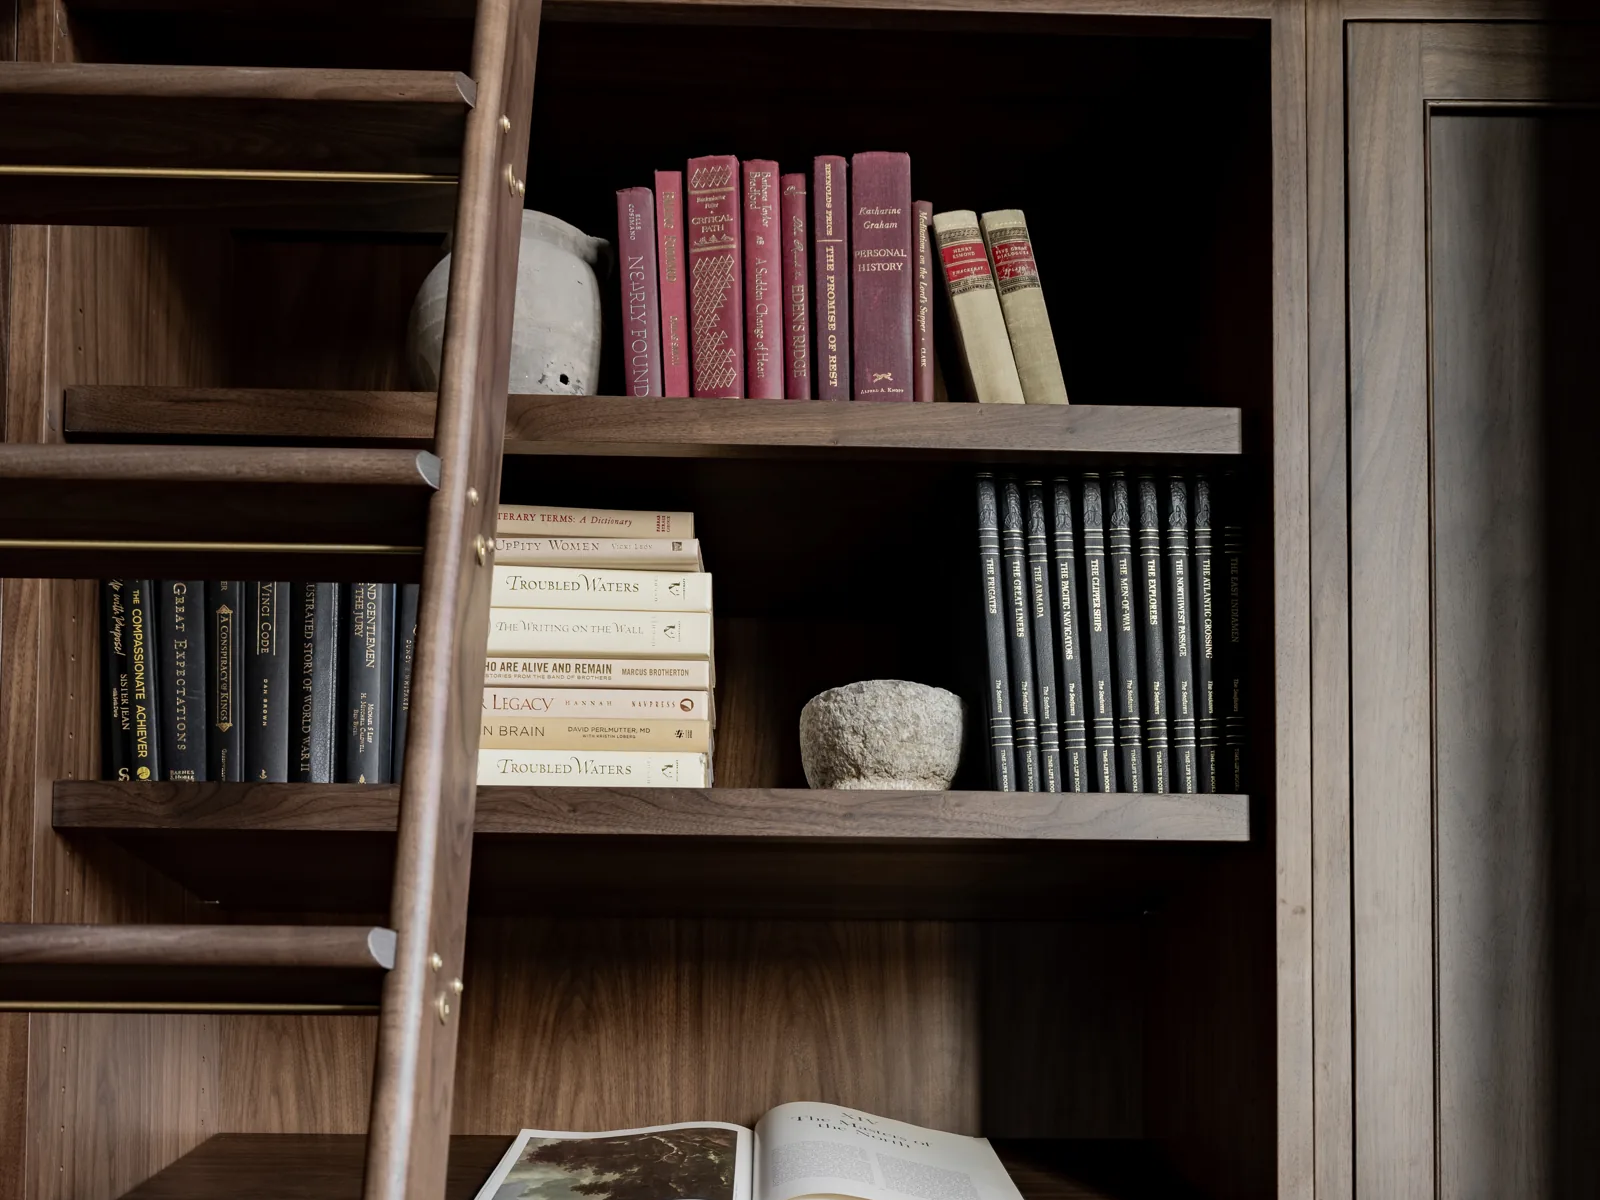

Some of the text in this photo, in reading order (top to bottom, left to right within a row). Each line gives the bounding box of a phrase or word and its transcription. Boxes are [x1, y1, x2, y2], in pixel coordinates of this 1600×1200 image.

[748, 171, 760, 210] Bradford
[761, 171, 771, 227] Barbara Taylor
[859, 206, 901, 215] Katharine
[628, 204, 636, 240] COSIMANO
[692, 215, 733, 224] CRITICAL
[702, 224, 724, 232] PATH
[863, 220, 898, 229] Graham
[855, 249, 907, 258] PERSONAL
[858, 263, 903, 272] HISTORY
[917, 210, 927, 332] Meditations on the Supper
[755, 267, 767, 300] Sudden
[755, 304, 768, 338] Change
[825, 246, 837, 387] THE PROMISE OF REST
[631, 329, 649, 397] FOUND
[754, 341, 768, 350] of
[756, 353, 768, 378] Heart
[793, 335, 806, 378] RIDGE
[540, 514, 575, 523] TERMS:
[591, 517, 632, 527] Dictionary
[496, 540, 599, 551] UPPITY WOMEN
[506, 576, 580, 591] TROUBLED
[578, 574, 639, 592] WATERS
[986, 558, 997, 613] THE FRIGATES
[1119, 558, 1127, 575] THE
[1231, 576, 1239, 597] EAST
[1012, 560, 1024, 637] THE GREAT LINERS
[1034, 566, 1044, 618] THE ARMADA
[1060, 562, 1073, 659] THE PACIFIC NAVIGATORS
[1091, 559, 1102, 632] THE CLIPPER SHIPS
[1147, 560, 1158, 625] THE EXPLORERS
[1175, 559, 1187, 656] THE NORTHWEST PASSAGE
[1202, 559, 1213, 659] THE ATLANTIC CROSSING
[109, 594, 126, 656] with Purpose!
[261, 583, 272, 653] VINCI CODE
[353, 589, 364, 638] THE JURY
[496, 622, 518, 631] THE
[520, 620, 569, 632] WRITING
[591, 625, 611, 633] THE
[611, 623, 643, 635] WALL
[132, 609, 145, 700] COMPASSIONATE
[220, 625, 228, 682] CONSPIRACY
[365, 602, 376, 668] GENTLEMEN
[173, 582, 188, 751] GREAT EXPECTATIONS
[500, 663, 612, 674] ARE ALIVE AND REMAIN
[120, 674, 130, 730] SISTER JEAN
[220, 692, 229, 721] KINGS
[300, 643, 312, 772] STORY OF WORLD WAR II
[493, 695, 554, 712] LEGACY
[137, 705, 147, 757] ACHIEVER
[500, 727, 545, 736] BRAIN
[497, 759, 572, 773] TROUBLED
[570, 757, 631, 774] WATERS
